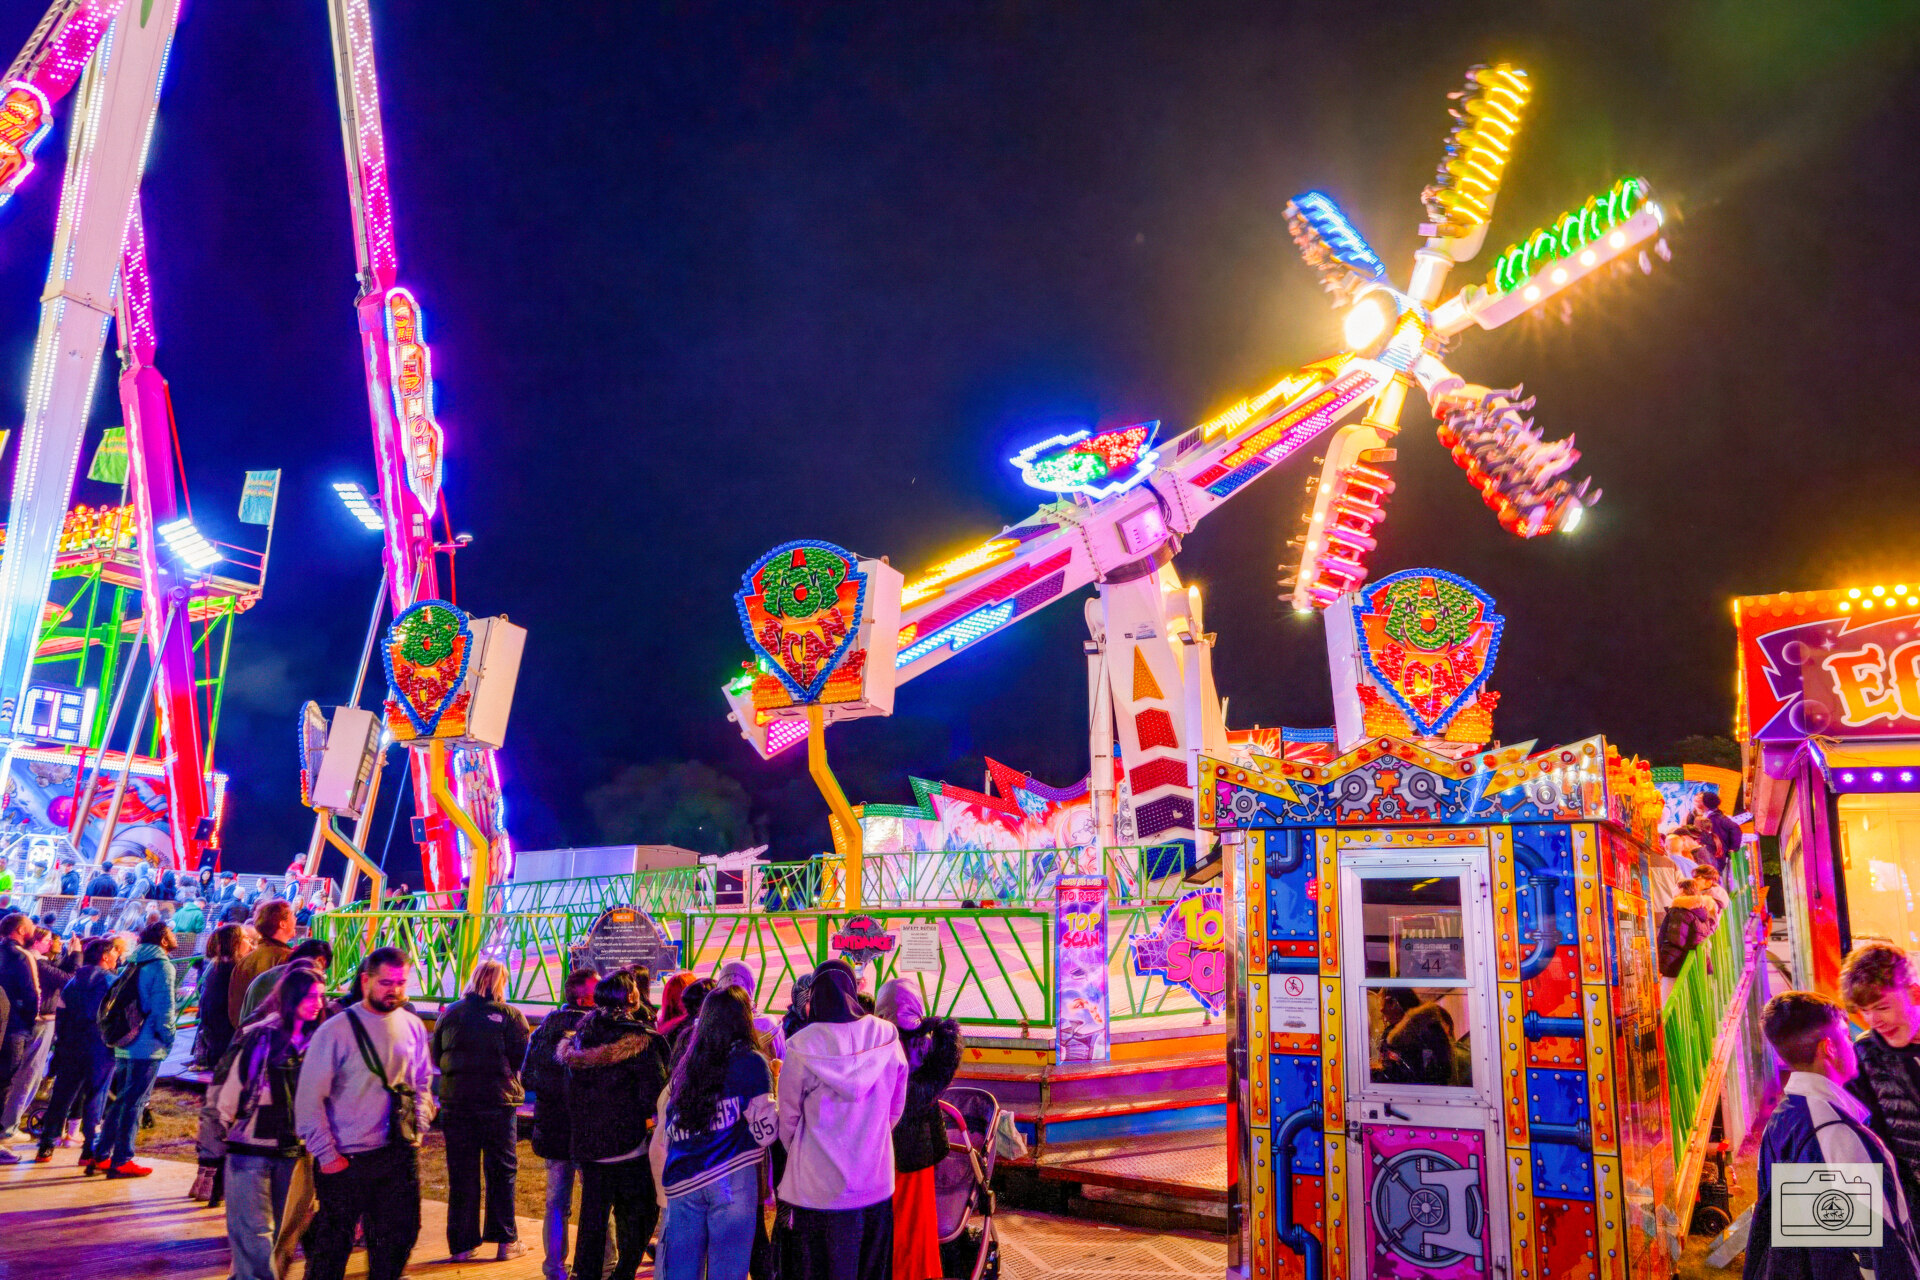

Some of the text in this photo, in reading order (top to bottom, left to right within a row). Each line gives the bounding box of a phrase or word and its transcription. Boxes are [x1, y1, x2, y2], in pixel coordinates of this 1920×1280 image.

[759, 547, 847, 619] TOP
[1382, 577, 1480, 650] TOP
[758, 606, 849, 691] SCAN
[1376, 641, 1481, 727] SCAN
[1062, 890, 1076, 902] TO
[1066, 911, 1101, 932] TOP
[832, 934, 892, 951] ENTRANCE
[1062, 930, 1099, 949] SCAN
[1421, 959, 1442, 973] 44
[752, 1116, 775, 1141] 95
